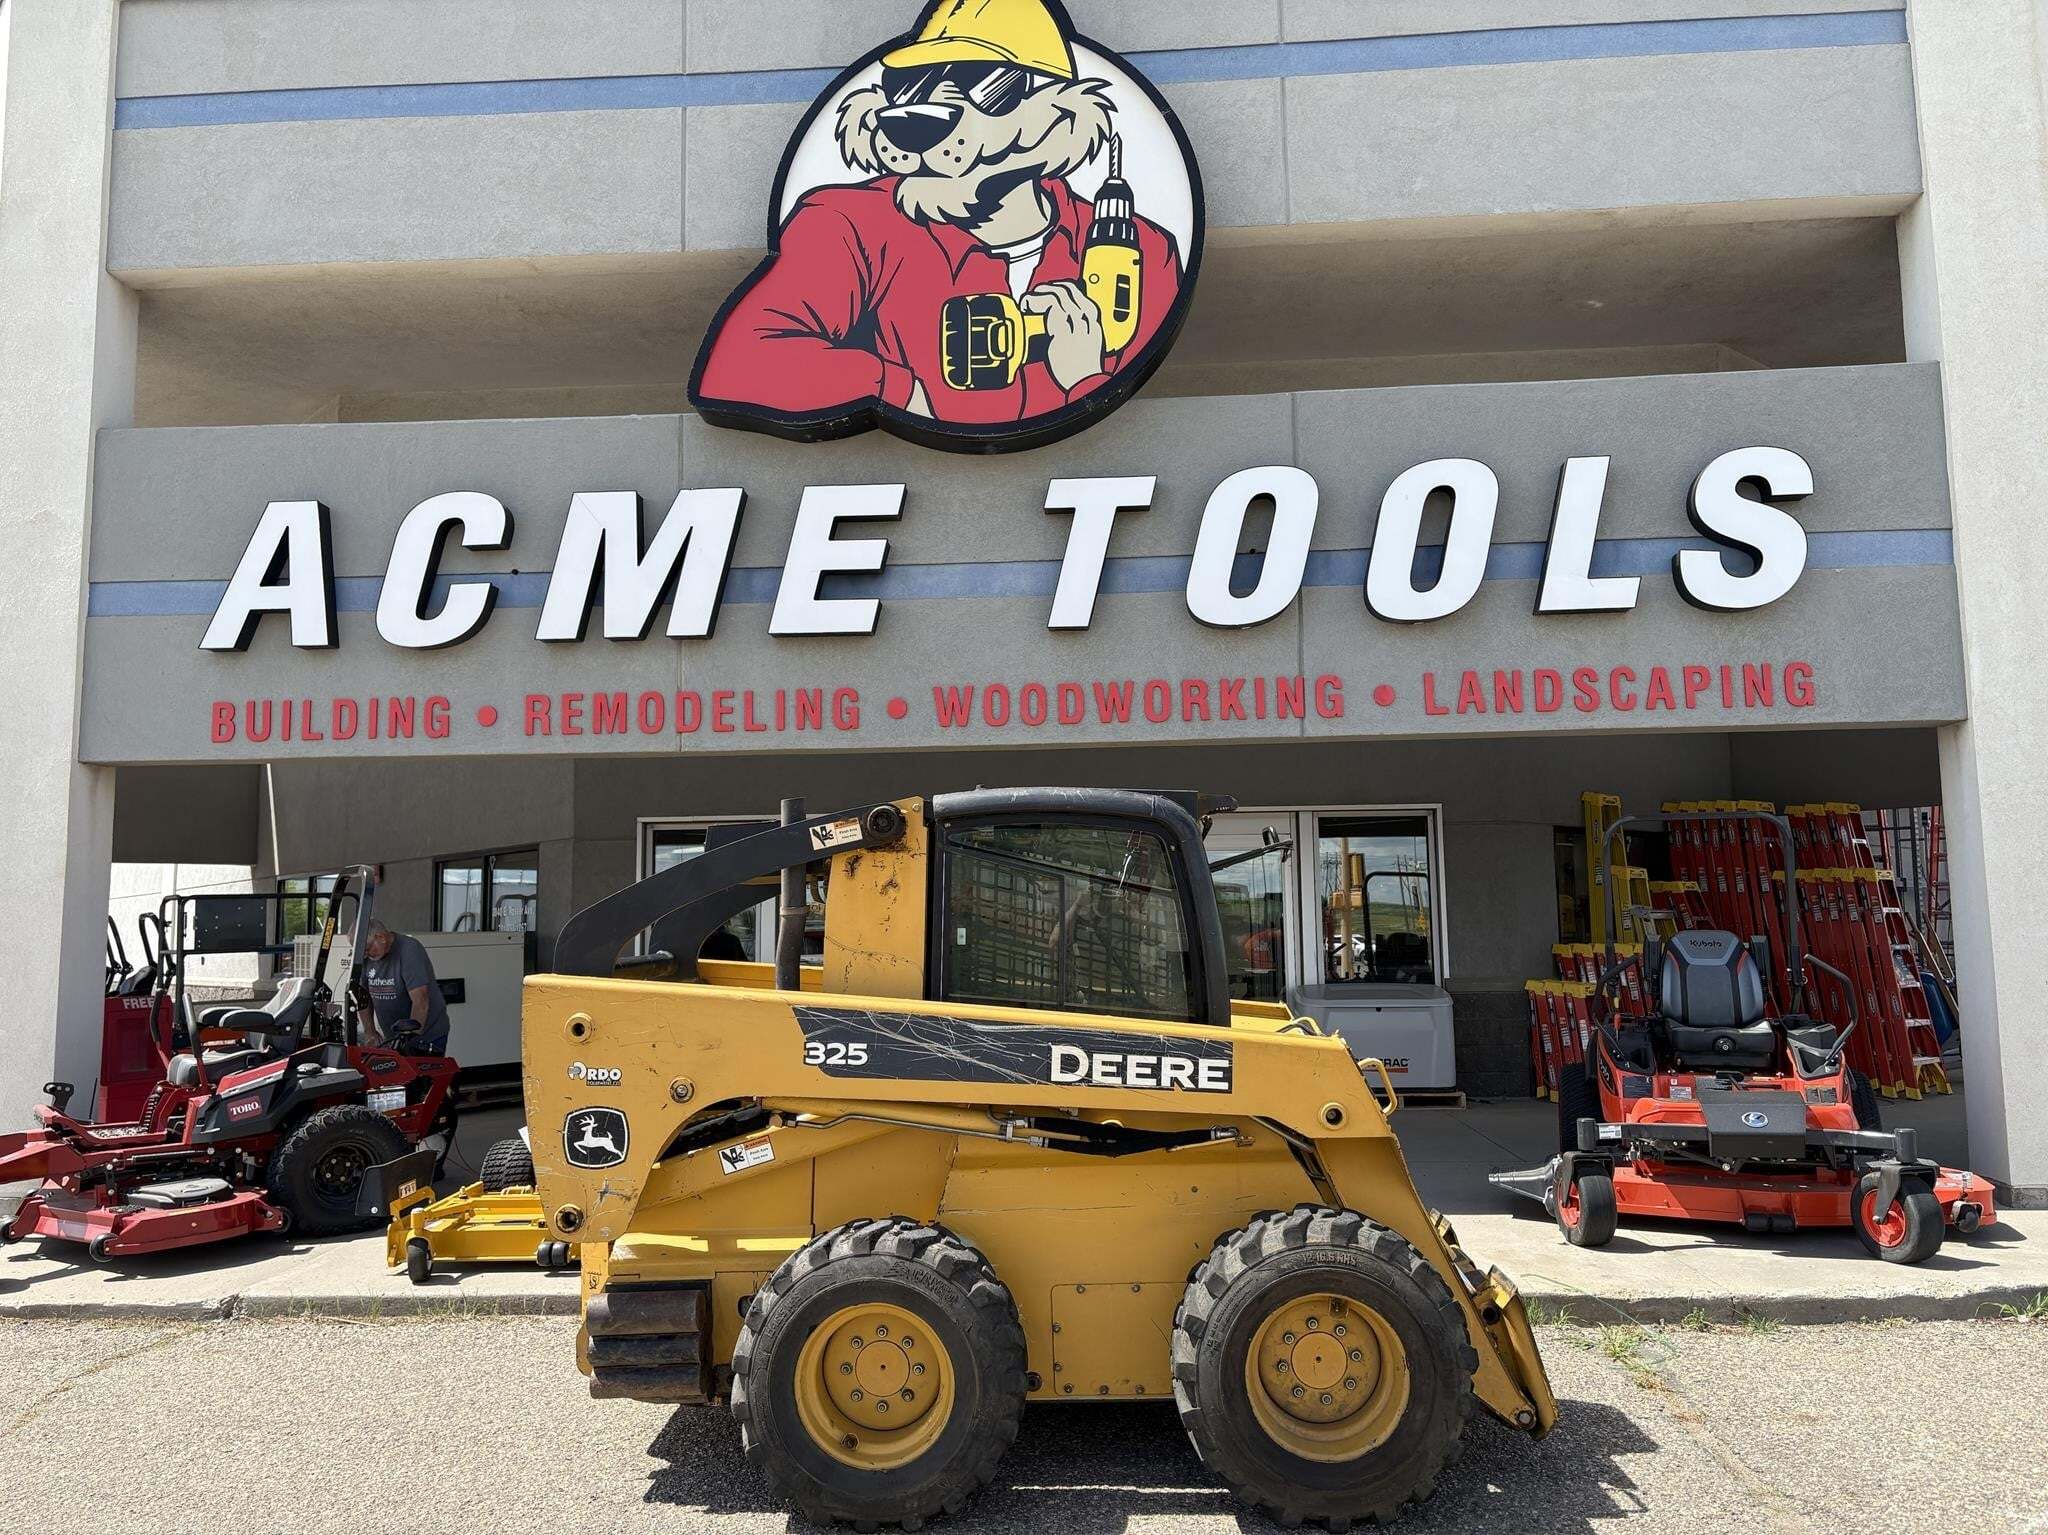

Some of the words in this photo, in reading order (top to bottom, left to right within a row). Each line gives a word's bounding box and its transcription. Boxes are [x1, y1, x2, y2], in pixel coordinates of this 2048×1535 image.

[200, 483, 908, 650] ACME
[1045, 446, 1815, 628] TOOLS
[211, 695, 450, 743] BUILDING
[524, 687, 861, 737] REMODELING
[933, 675, 1345, 728] WOODWORKING
[1423, 661, 1816, 716] LANDSCAPING
[804, 1041, 868, 1066] 325
[1047, 1042, 1231, 1090] DEERE
[587, 1068, 622, 1080] RDO
[230, 1101, 259, 1115] TORO
